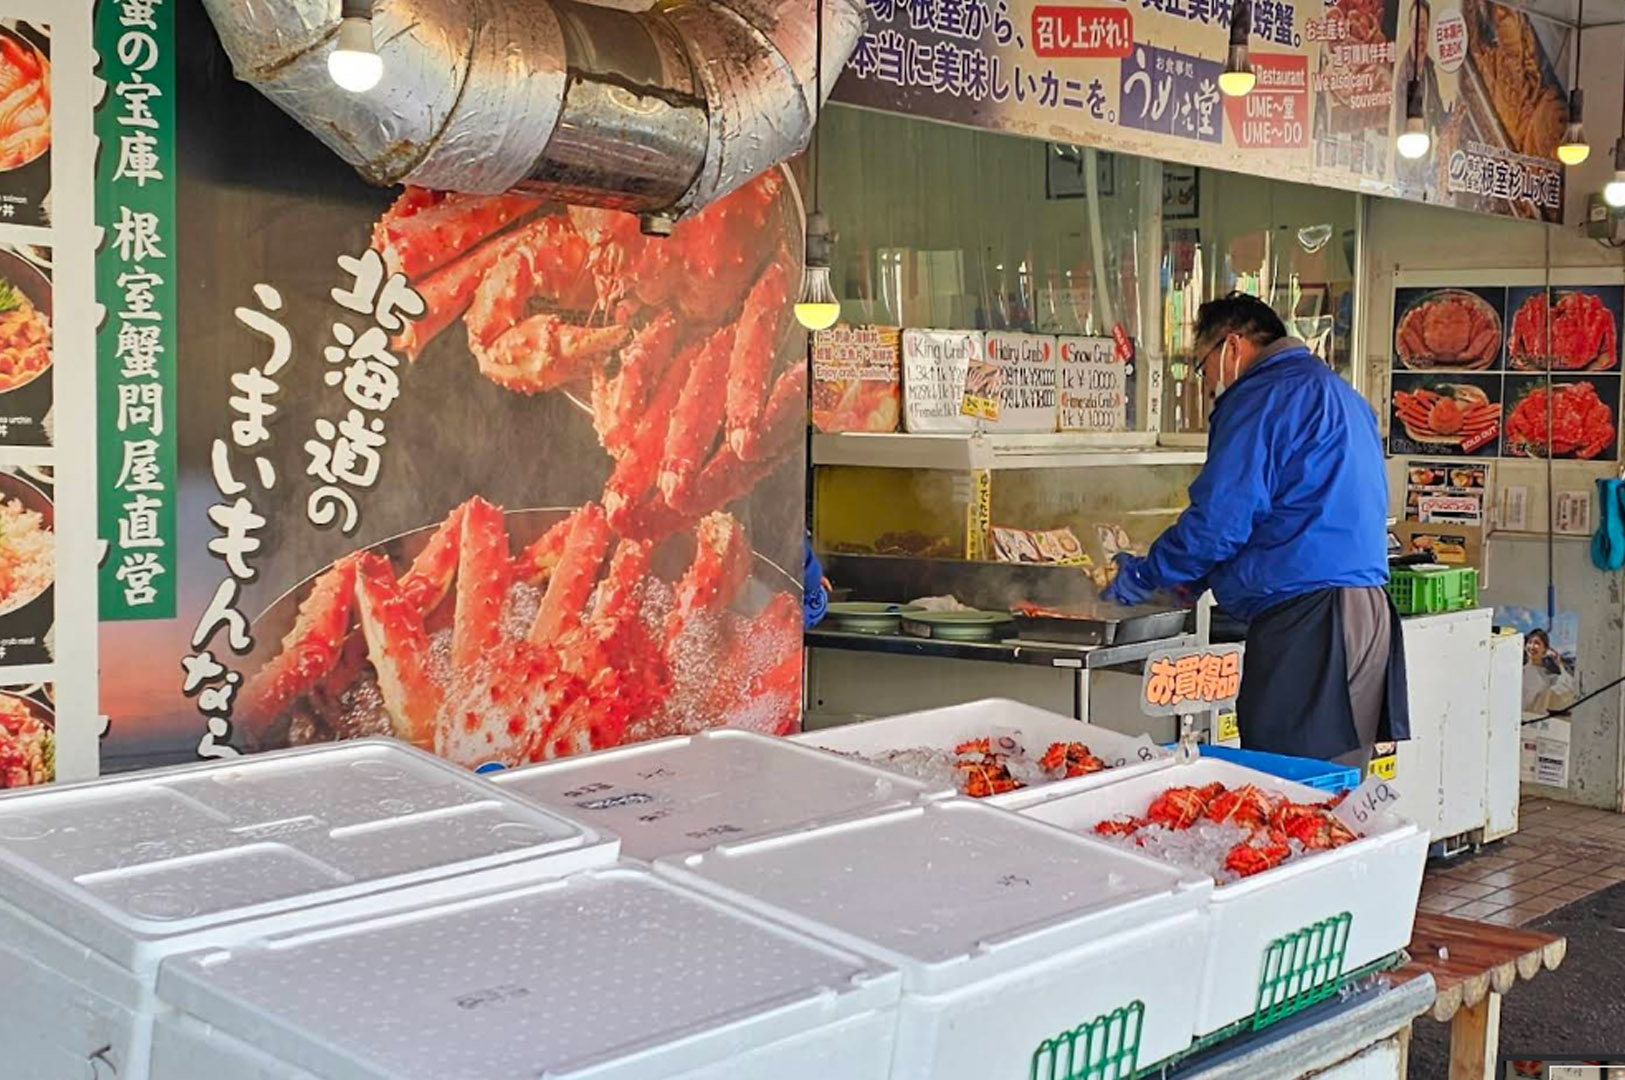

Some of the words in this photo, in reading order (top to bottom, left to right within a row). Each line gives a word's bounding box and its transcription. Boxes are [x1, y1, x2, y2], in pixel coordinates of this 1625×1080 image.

[1037, 16, 1130, 50] 召し上がれ!
[849, 32, 1116, 124] 本当に美味しいカニを。
[1257, 64, 1306, 86] Restaurant
[914, 336, 941, 366] King
[995, 338, 1020, 366] Hairy
[1021, 339, 1043, 362] Crab
[1068, 342, 1092, 362] Snow
[111, 206, 167, 606] 根室蟹問屋直営
[304, 248, 426, 533] 北海道の
[1462, 434, 1481, 451] SOLD
[1481, 425, 1498, 442] OUT
[1146, 653, 1239, 705] お買得品
